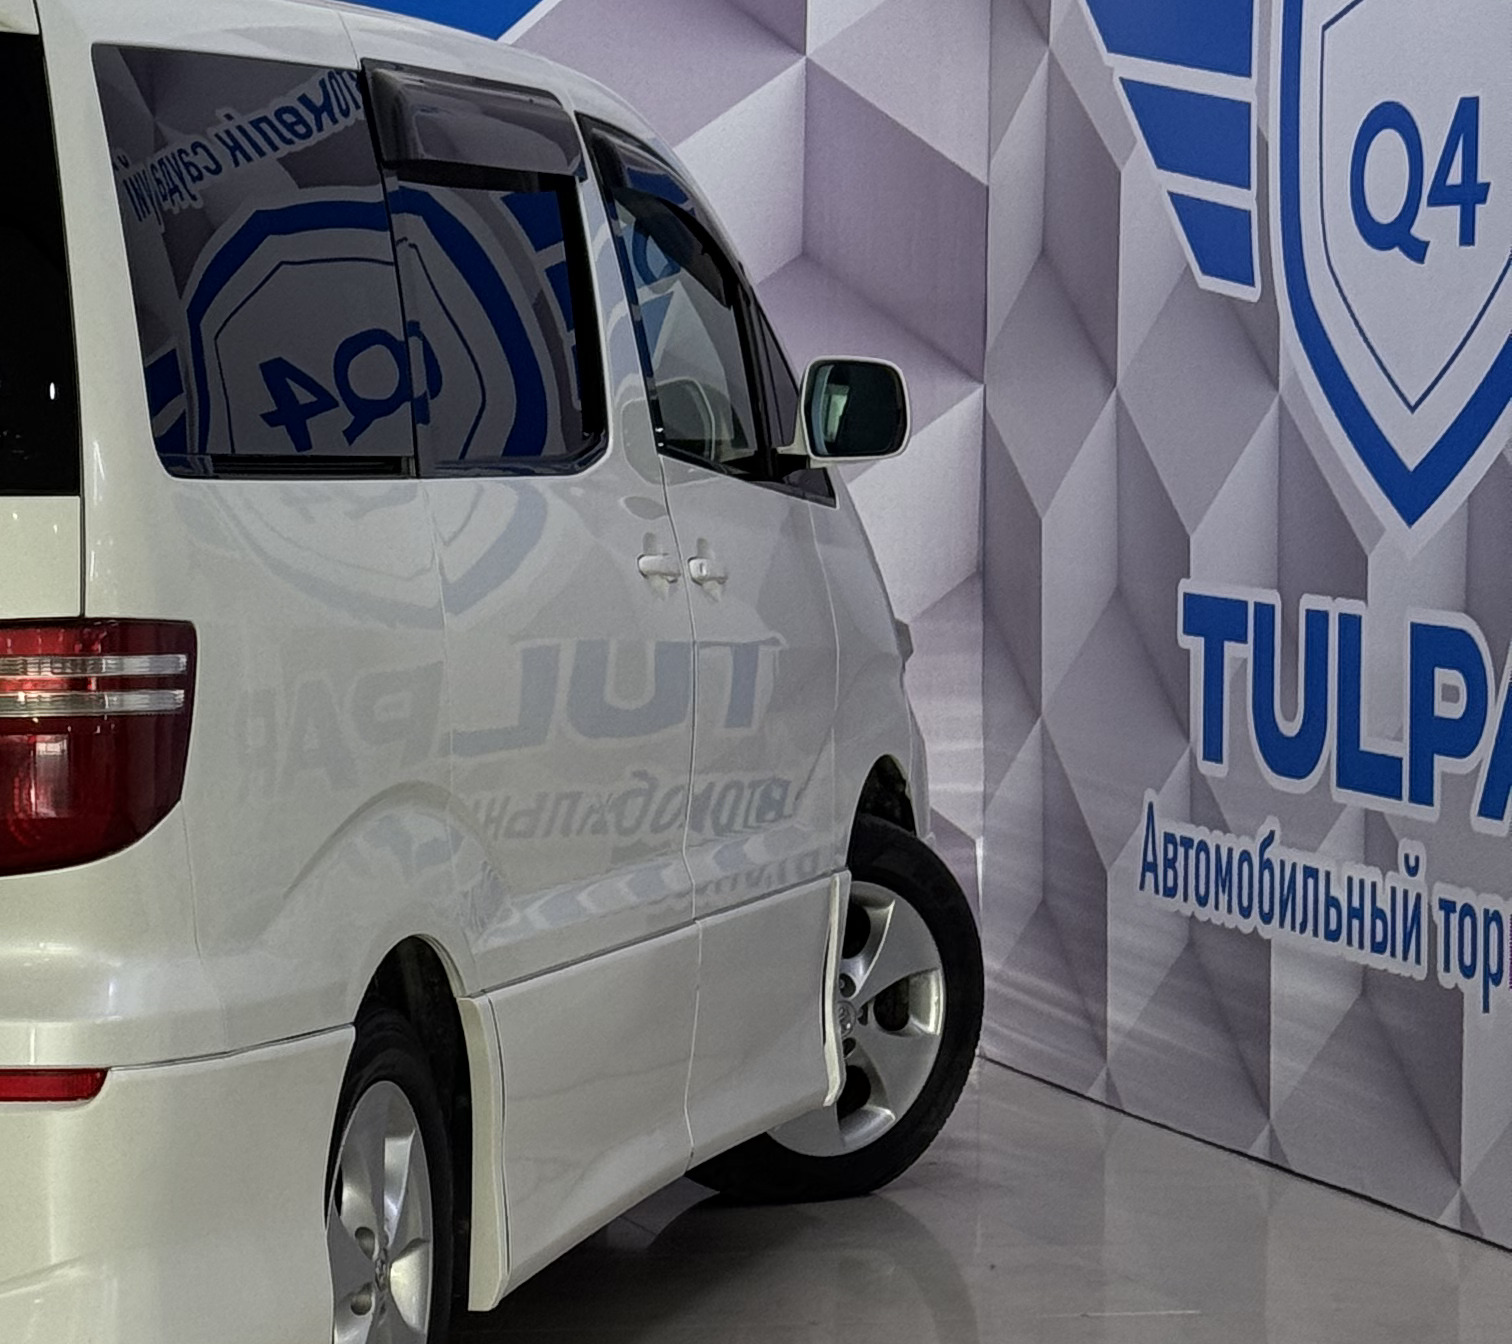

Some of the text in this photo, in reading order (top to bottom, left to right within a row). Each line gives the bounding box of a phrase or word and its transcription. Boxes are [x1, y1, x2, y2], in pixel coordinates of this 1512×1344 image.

[1349, 96, 1491, 264] Q4
[1139, 801, 1512, 1015] Автомобильный тор
